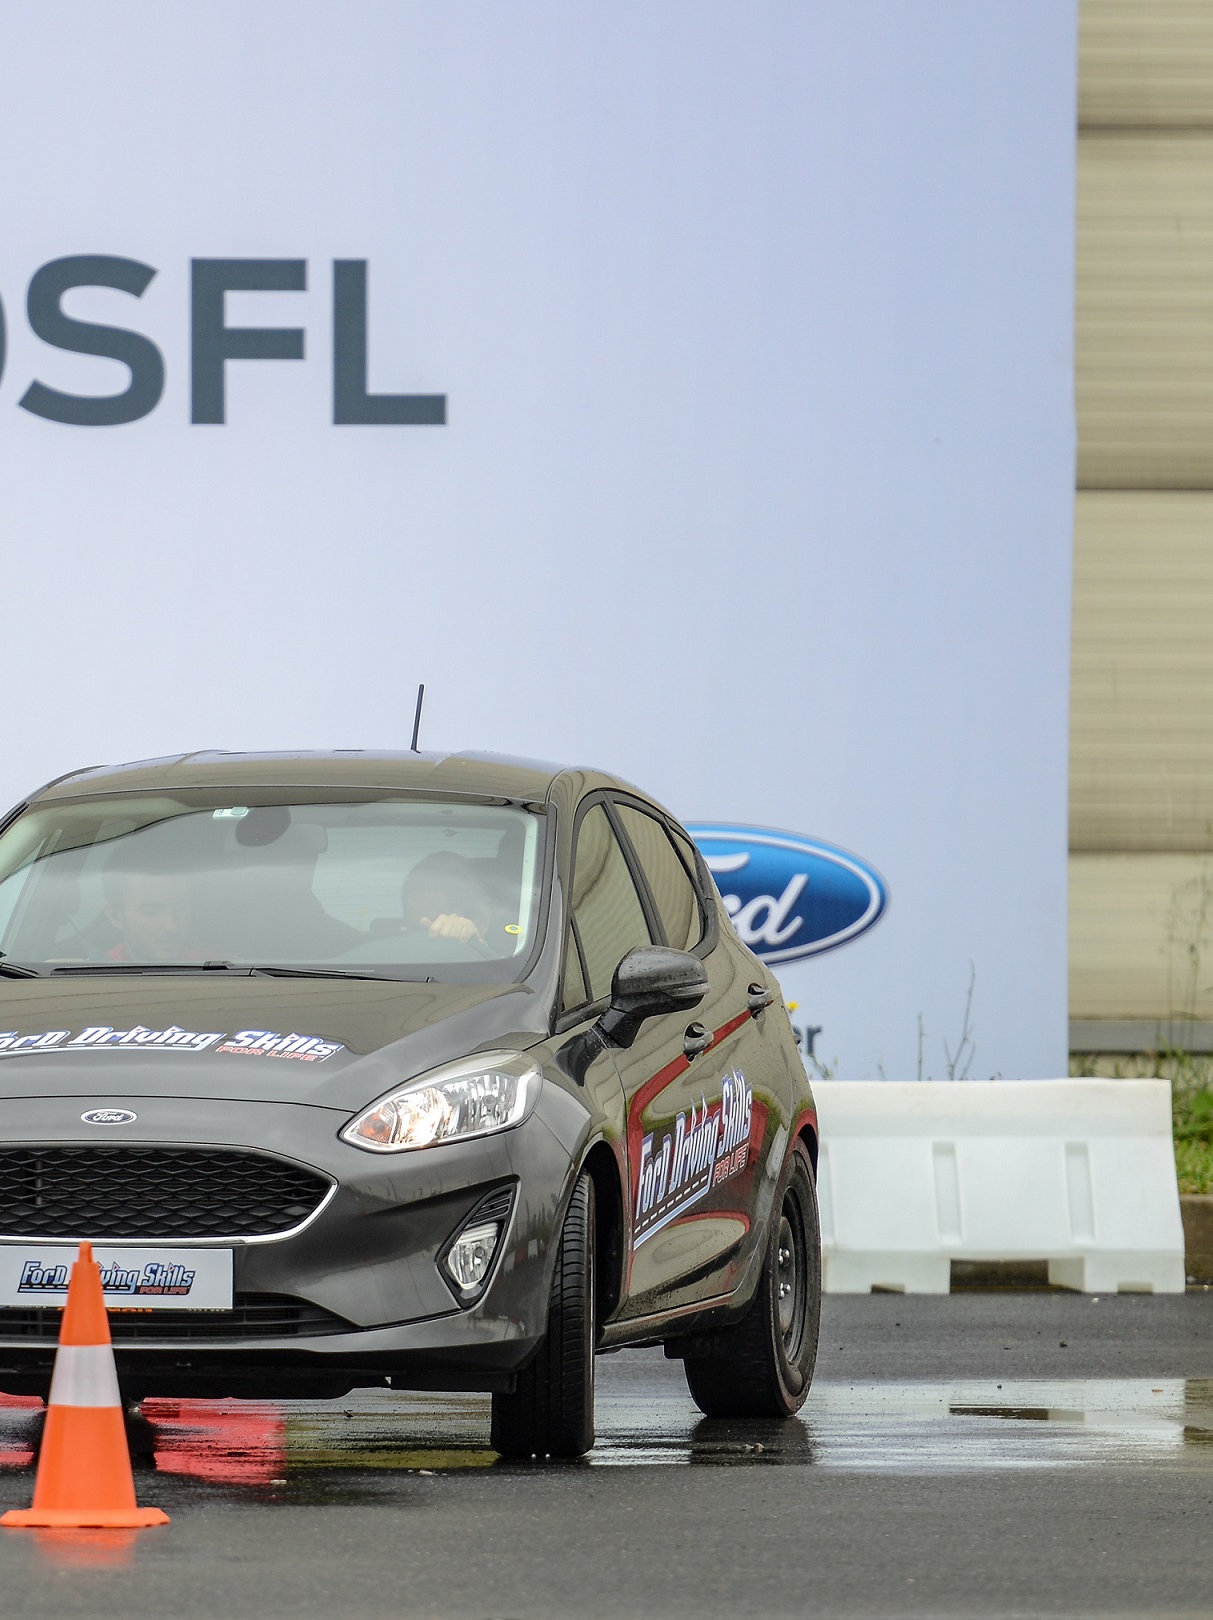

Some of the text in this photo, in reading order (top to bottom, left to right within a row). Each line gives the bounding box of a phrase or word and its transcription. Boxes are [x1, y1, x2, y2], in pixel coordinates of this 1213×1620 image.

[68, 1024, 227, 1051] Driving
[223, 1030, 345, 1056] Skills
[215, 1046, 320, 1062] FOR LIFE
[92, 1111, 125, 1121] Ford
[668, 1091, 721, 1191] Driving
[717, 1065, 753, 1158] Skills
[729, 1143, 749, 1175] LIFE
[95, 1260, 140, 1293] ving
[140, 1262, 195, 1287] Skills
[140, 1286, 187, 1295] FOR LIFE
